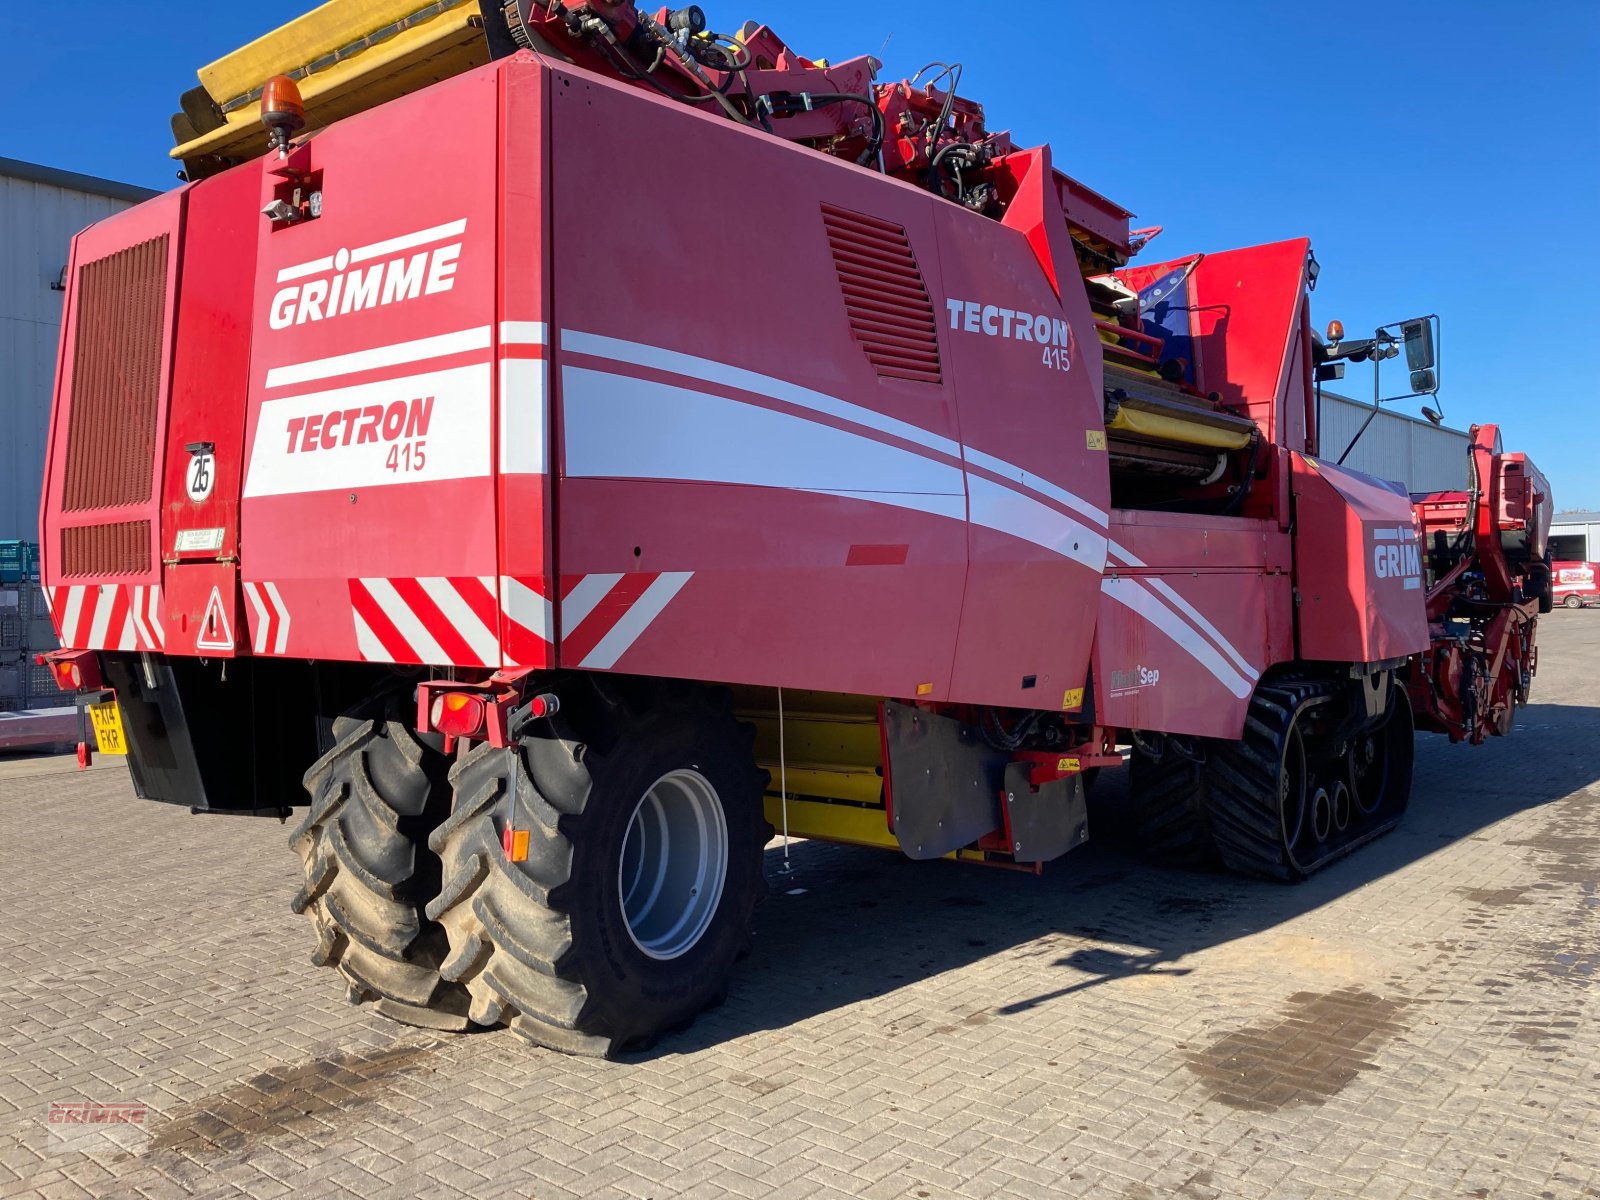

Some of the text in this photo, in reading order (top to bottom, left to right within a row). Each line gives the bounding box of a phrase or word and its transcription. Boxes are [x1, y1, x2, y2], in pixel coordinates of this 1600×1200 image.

[269, 242, 463, 330] GRIMME
[946, 298, 1068, 347] TECTRON
[1042, 346, 1070, 372] 415
[286, 396, 435, 454] TECTRON
[385, 441, 427, 473] 415
[192, 458, 211, 493] 25
[92, 704, 115, 726] FX14
[100, 729, 120, 749] FKR
